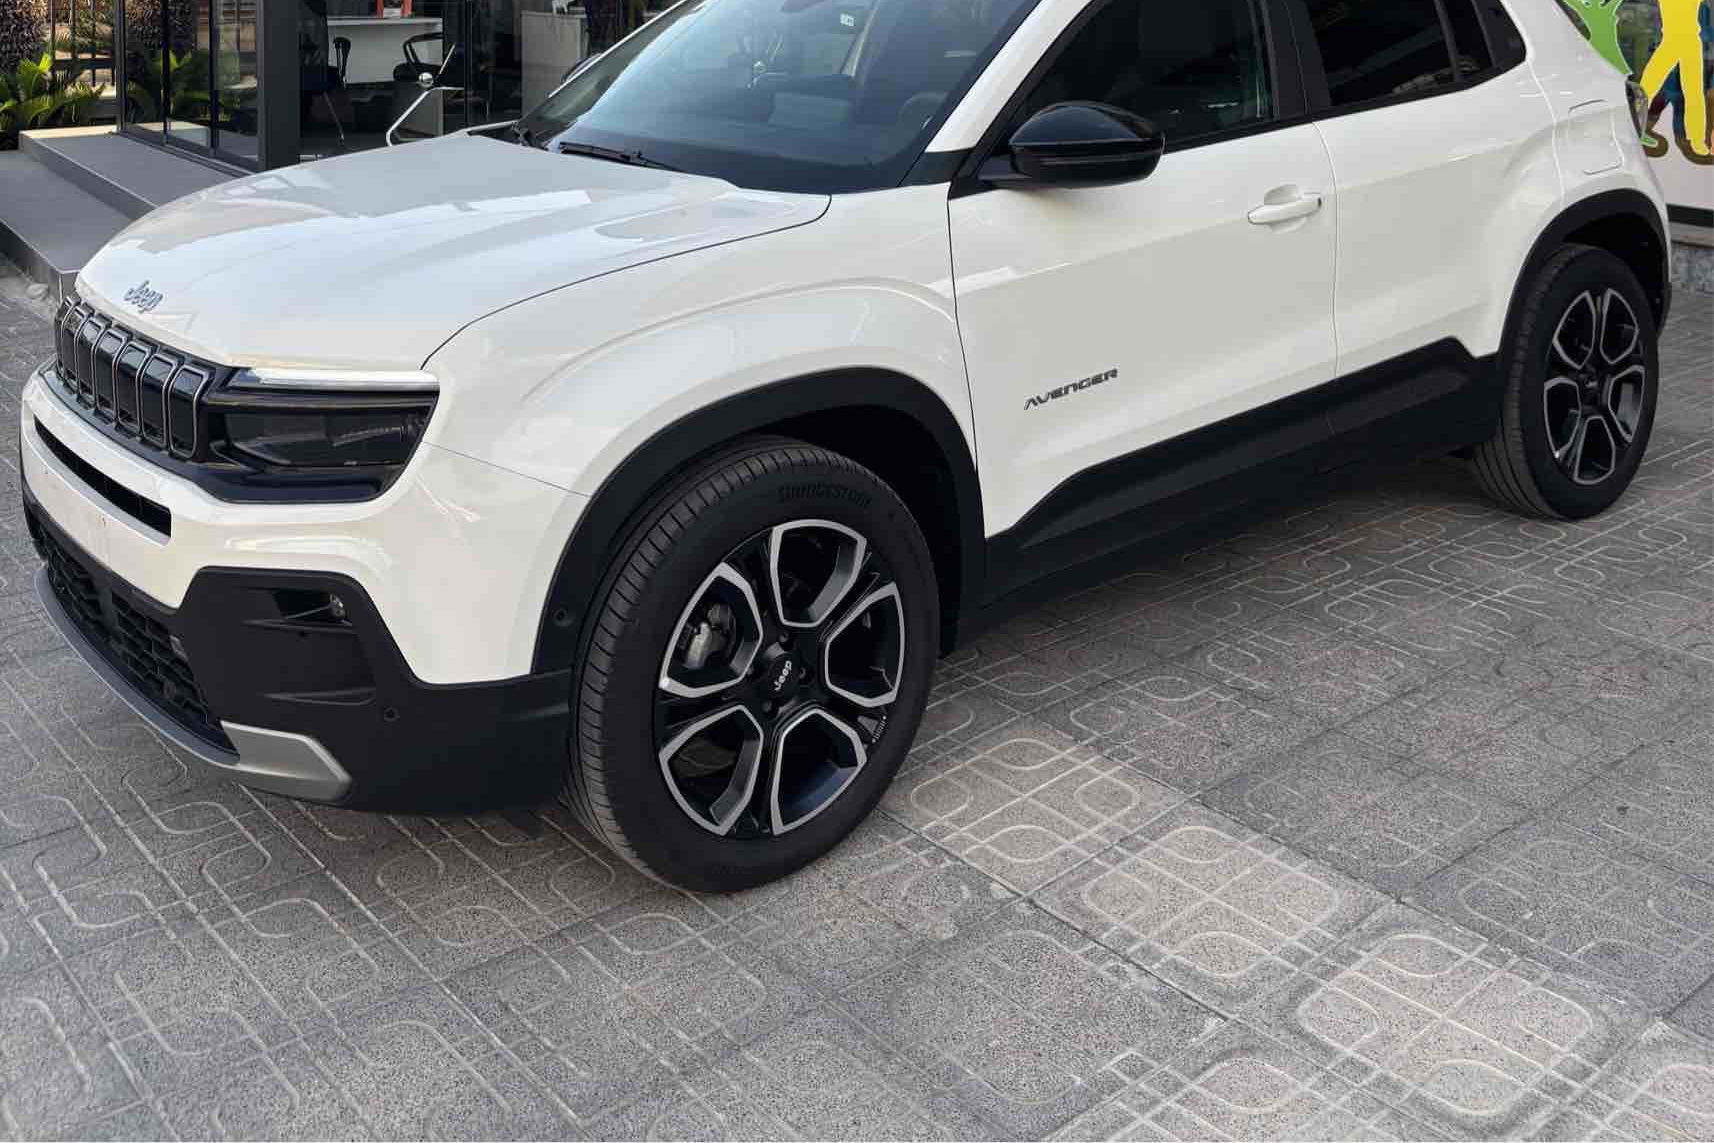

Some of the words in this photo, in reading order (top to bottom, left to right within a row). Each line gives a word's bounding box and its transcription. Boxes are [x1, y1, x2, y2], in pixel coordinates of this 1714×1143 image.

[123, 279, 164, 314] Jeep
[1023, 368, 1118, 410] AVENGER
[774, 660, 792, 692] Jeep
